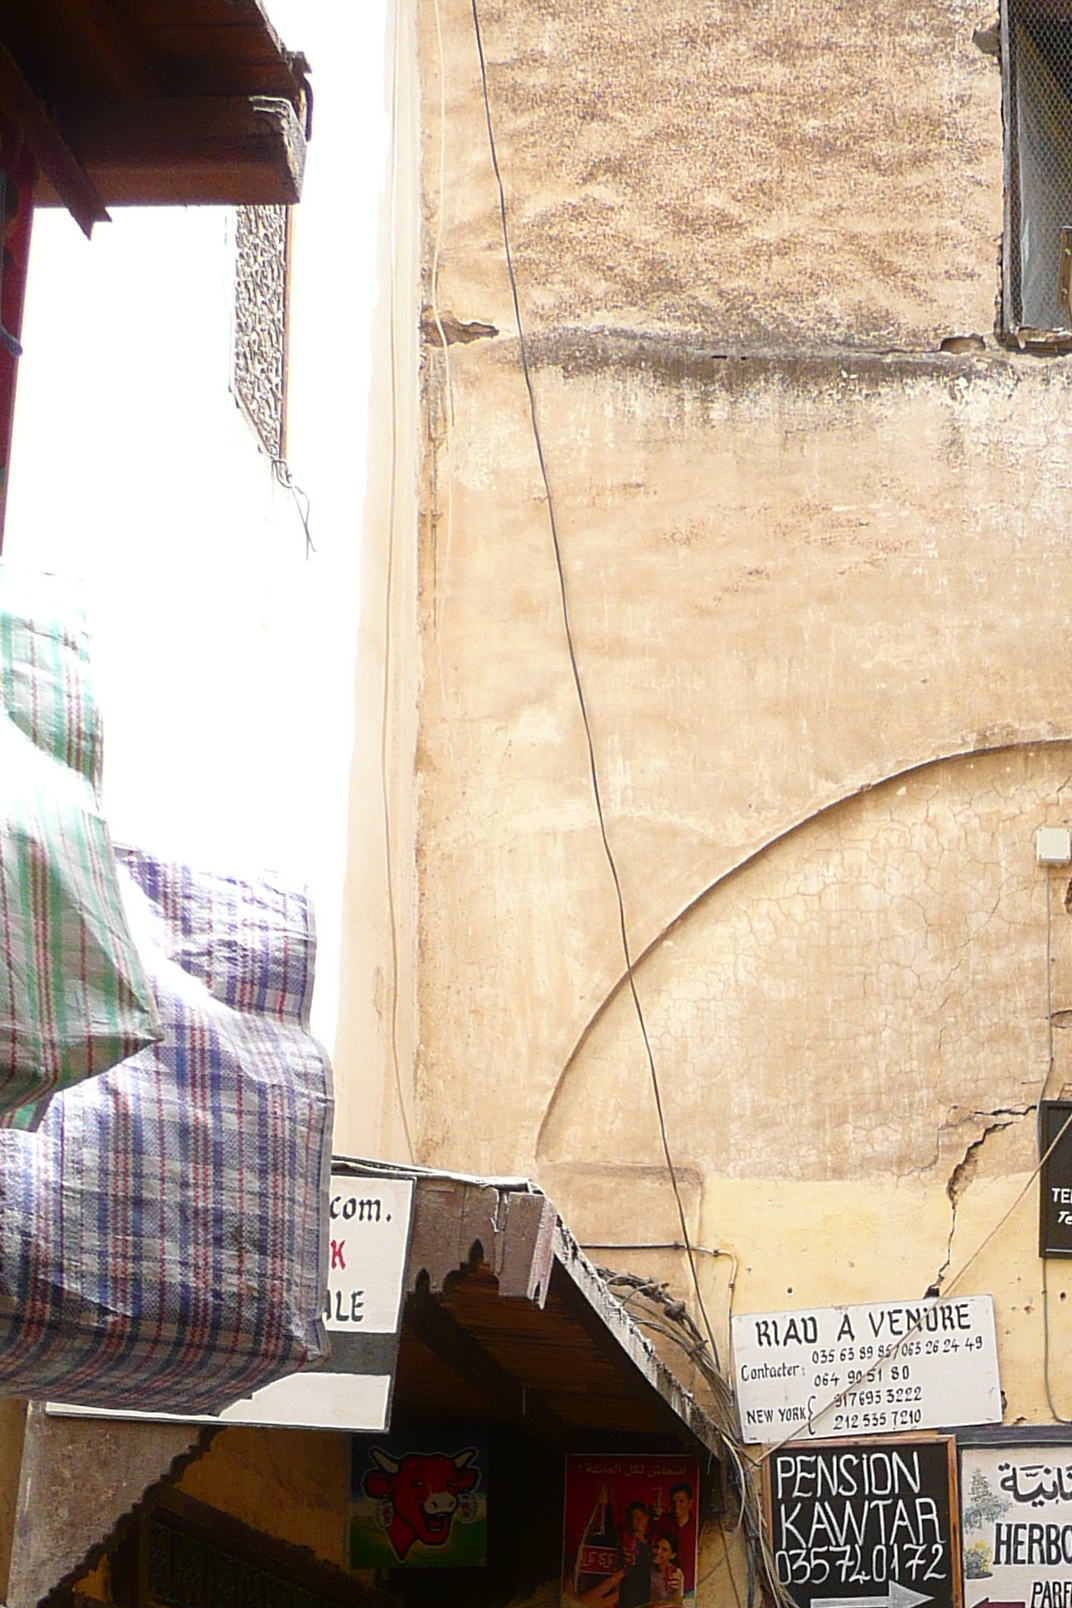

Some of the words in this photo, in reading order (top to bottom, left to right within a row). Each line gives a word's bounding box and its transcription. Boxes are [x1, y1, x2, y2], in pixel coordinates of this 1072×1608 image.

[755, 1316, 818, 1348] RIAD
[836, 1314, 856, 1343] A
[868, 1303, 972, 1339] VENDRE
[812, 1349, 835, 1364] 035
[860, 1345, 873, 1360] 89
[925, 1340, 940, 1354] 26
[942, 1338, 960, 1353] 24
[965, 1335, 983, 1351] 49
[814, 1372, 840, 1387] 064
[867, 1367, 883, 1383] 51
[746, 1410, 774, 1424] NEW
[778, 1405, 807, 1421] YORK
[833, 1415, 859, 1430] 212
[891, 1408, 922, 1426] 7210
[776, 1451, 920, 1499] PENSION
[780, 1497, 947, 1549] KAWTAR
